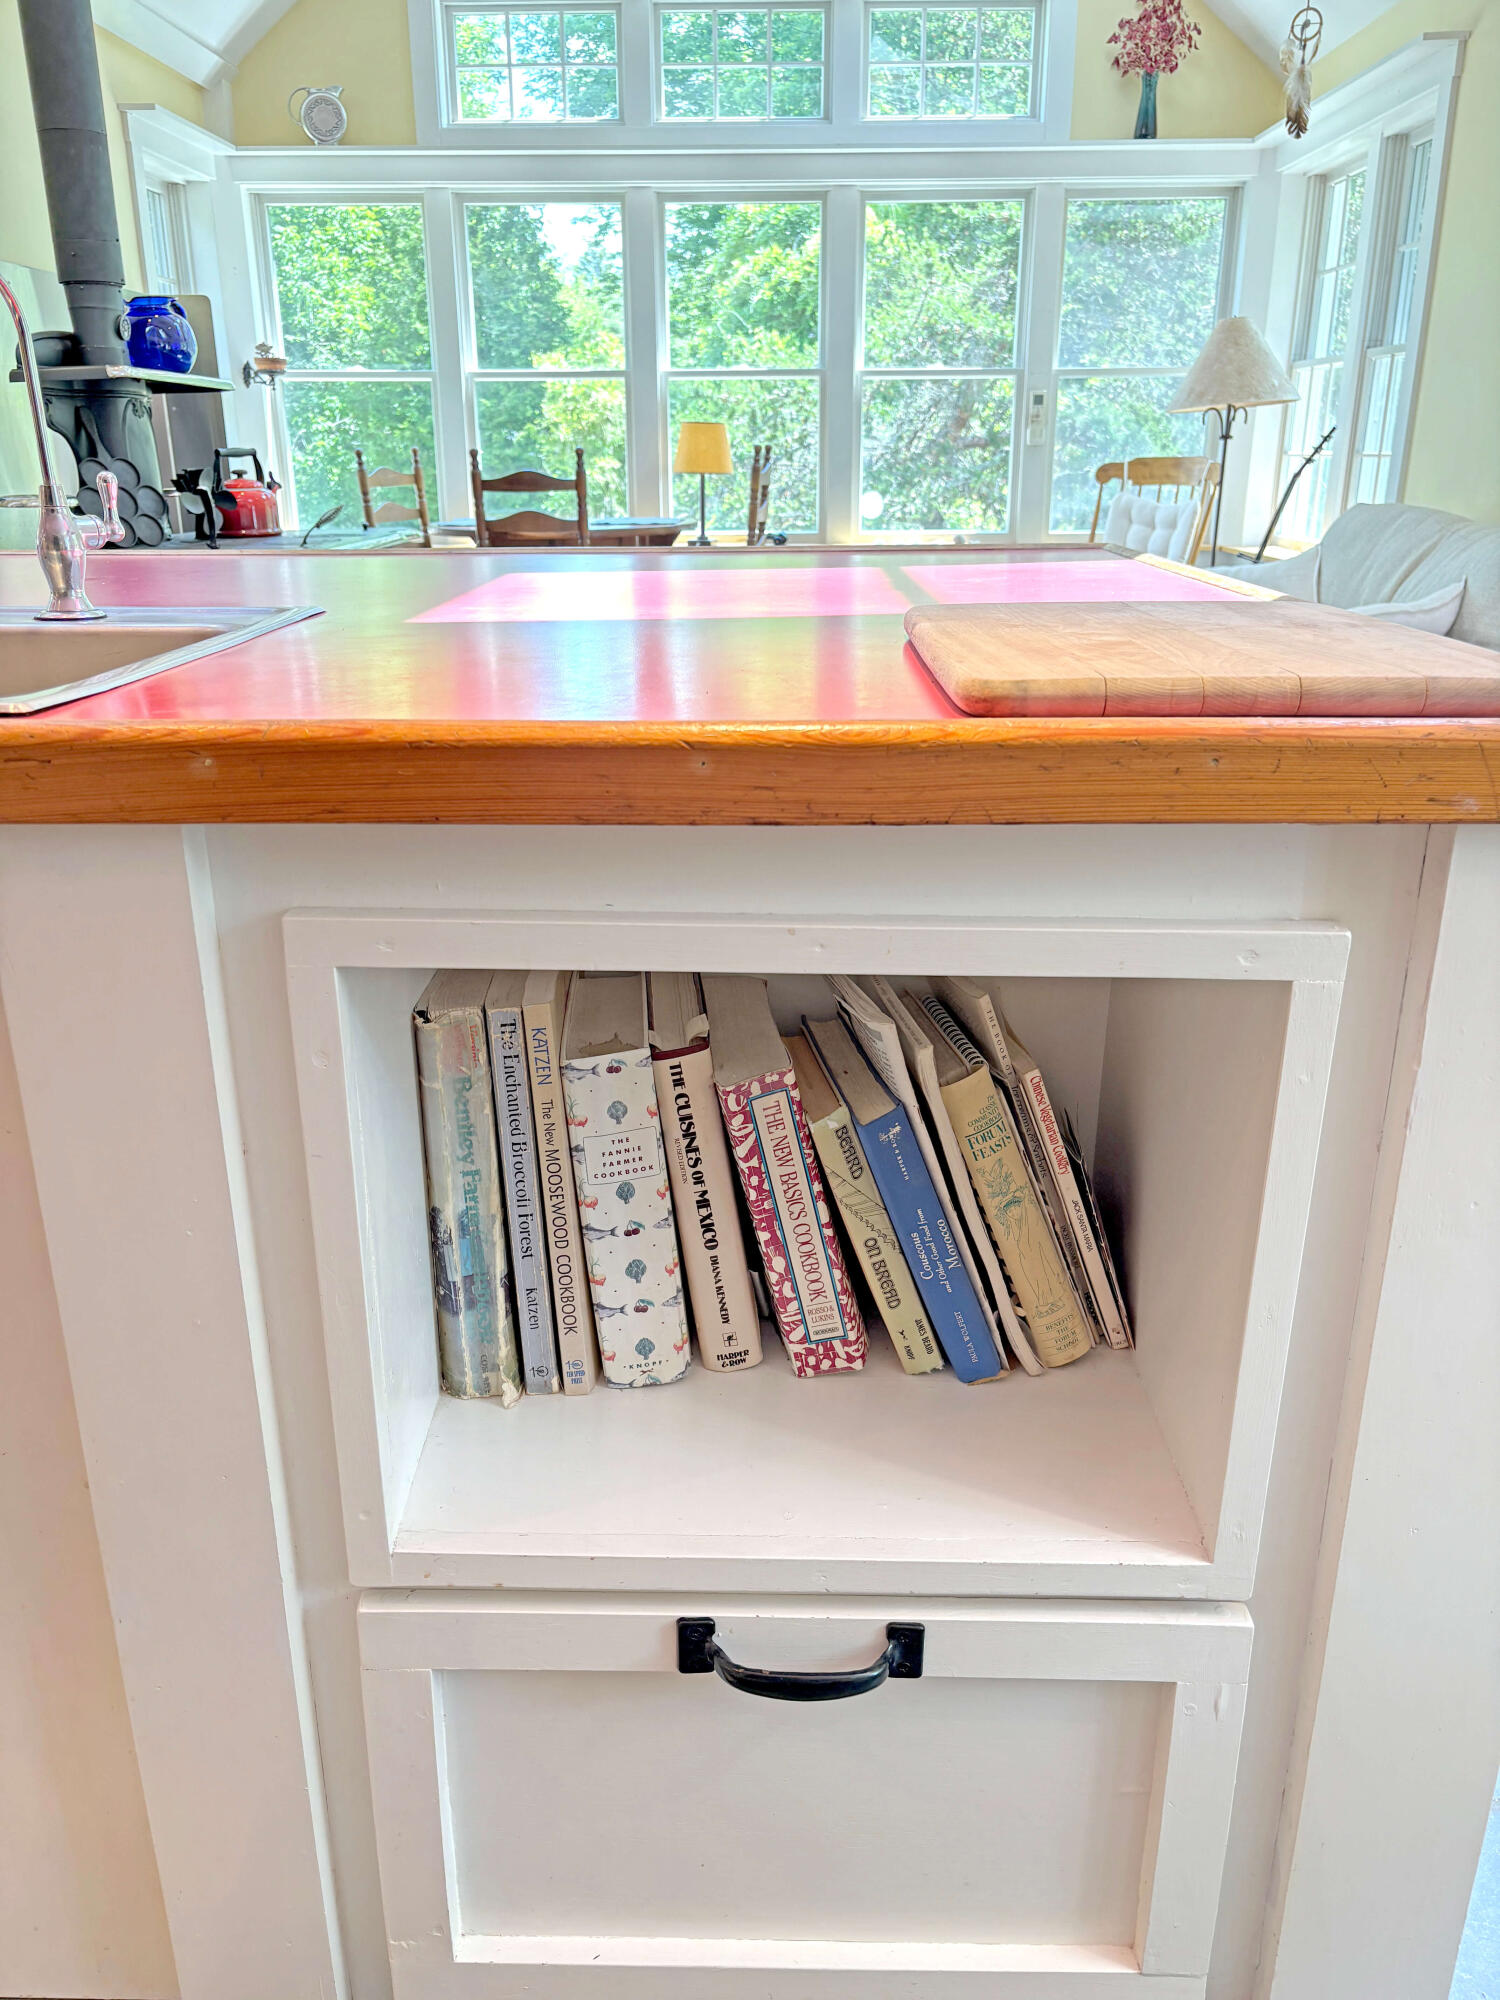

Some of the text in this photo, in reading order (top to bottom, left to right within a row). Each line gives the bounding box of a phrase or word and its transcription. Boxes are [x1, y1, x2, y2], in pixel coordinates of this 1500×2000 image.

[531, 1026, 552, 1086] KATZEN
[500, 1019, 534, 1260] The Enchanted Broccoli Forest
[611, 1137, 630, 1145] THE
[967, 1120, 1007, 1150] FORUM
[972, 1135, 1011, 1161] FEASTS
[1030, 1075, 1070, 1175] Chinese Vegetarian Cookery
[593, 1164, 654, 1179] COOKBOOK
[601, 1145, 642, 1158] FANNIE
[602, 1156, 644, 1168] FARMER
[669, 1061, 719, 1250] THE CUISINES OF MEXICO
[674, 1138, 688, 1184] REVISED EDITION
[541, 1098, 578, 1336] The New MOOSEWOOD COOKBOOK
[763, 1100, 828, 1302] THE NEW BASICS COOKBOOK
[936, 1218, 961, 1270] Morocco
[1072, 1200, 1095, 1253] JACK SANTA MARIA
[911, 1232, 934, 1280] Couscous
[917, 1208, 952, 1293] and Other Good Food from
[526, 1287, 540, 1331] Katzen
[709, 1255, 731, 1324] DIANA KENNEDY
[807, 1306, 829, 1316] ROSSO
[811, 1313, 835, 1324] LUKINS
[914, 1318, 934, 1355] JAMES BEARD
[953, 1311, 979, 1363] PAULA WOLFERT
[628, 1360, 663, 1370] KNOPF
[716, 1349, 749, 1361] HARPER
